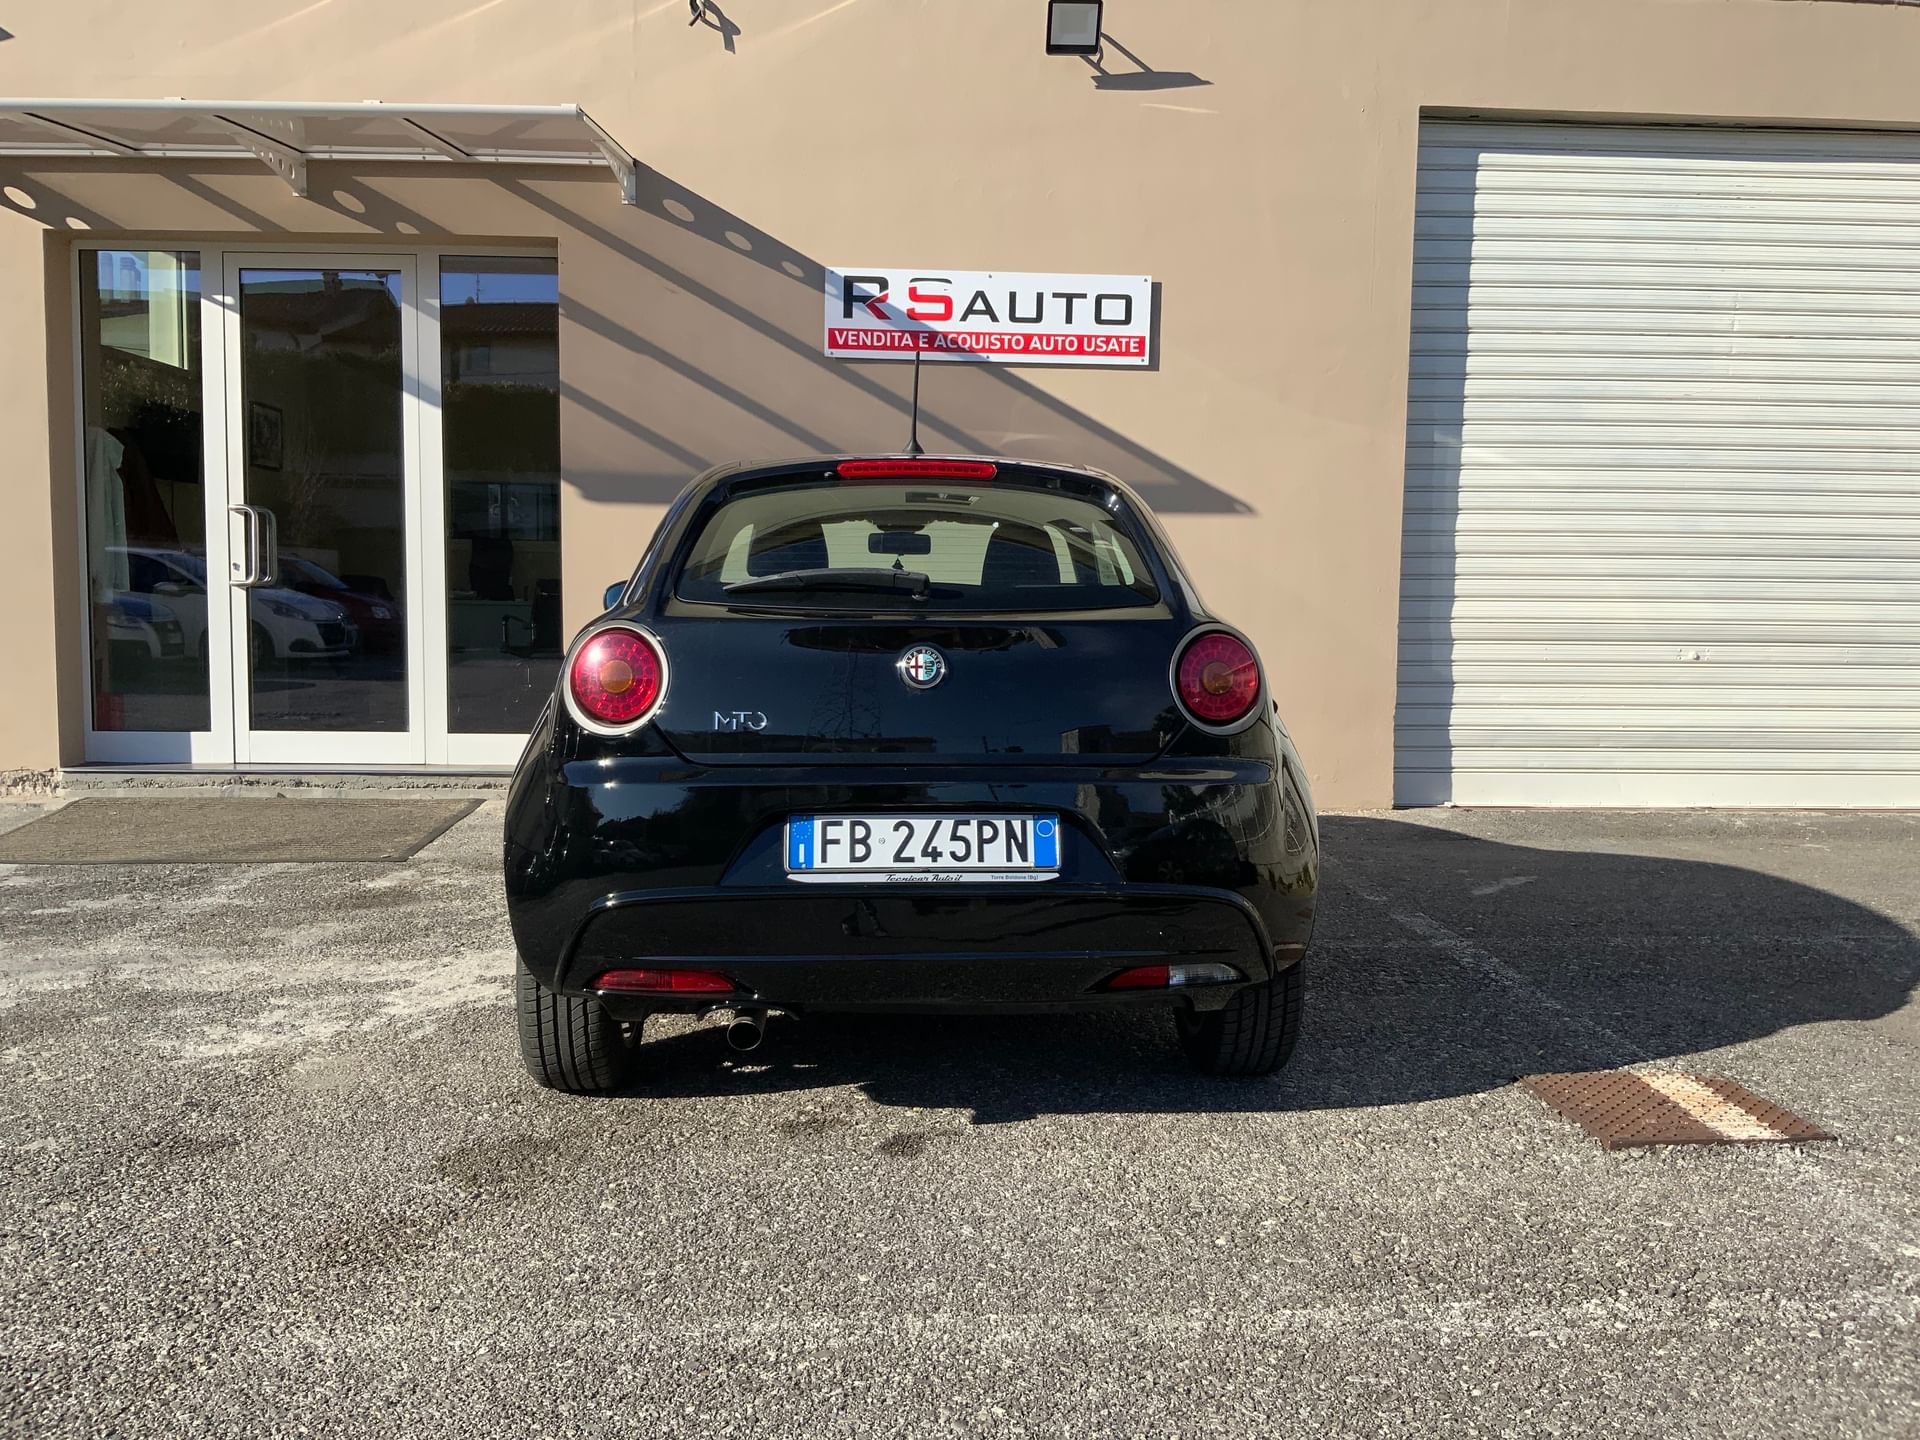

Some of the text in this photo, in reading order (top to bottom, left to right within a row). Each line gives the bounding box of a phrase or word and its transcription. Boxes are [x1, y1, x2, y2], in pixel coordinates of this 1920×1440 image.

[834, 330, 1140, 353] VENDITA E ACQUISTO AUTO USATE
[820, 820, 872, 863] FB
[892, 819, 1029, 863] 245PN
